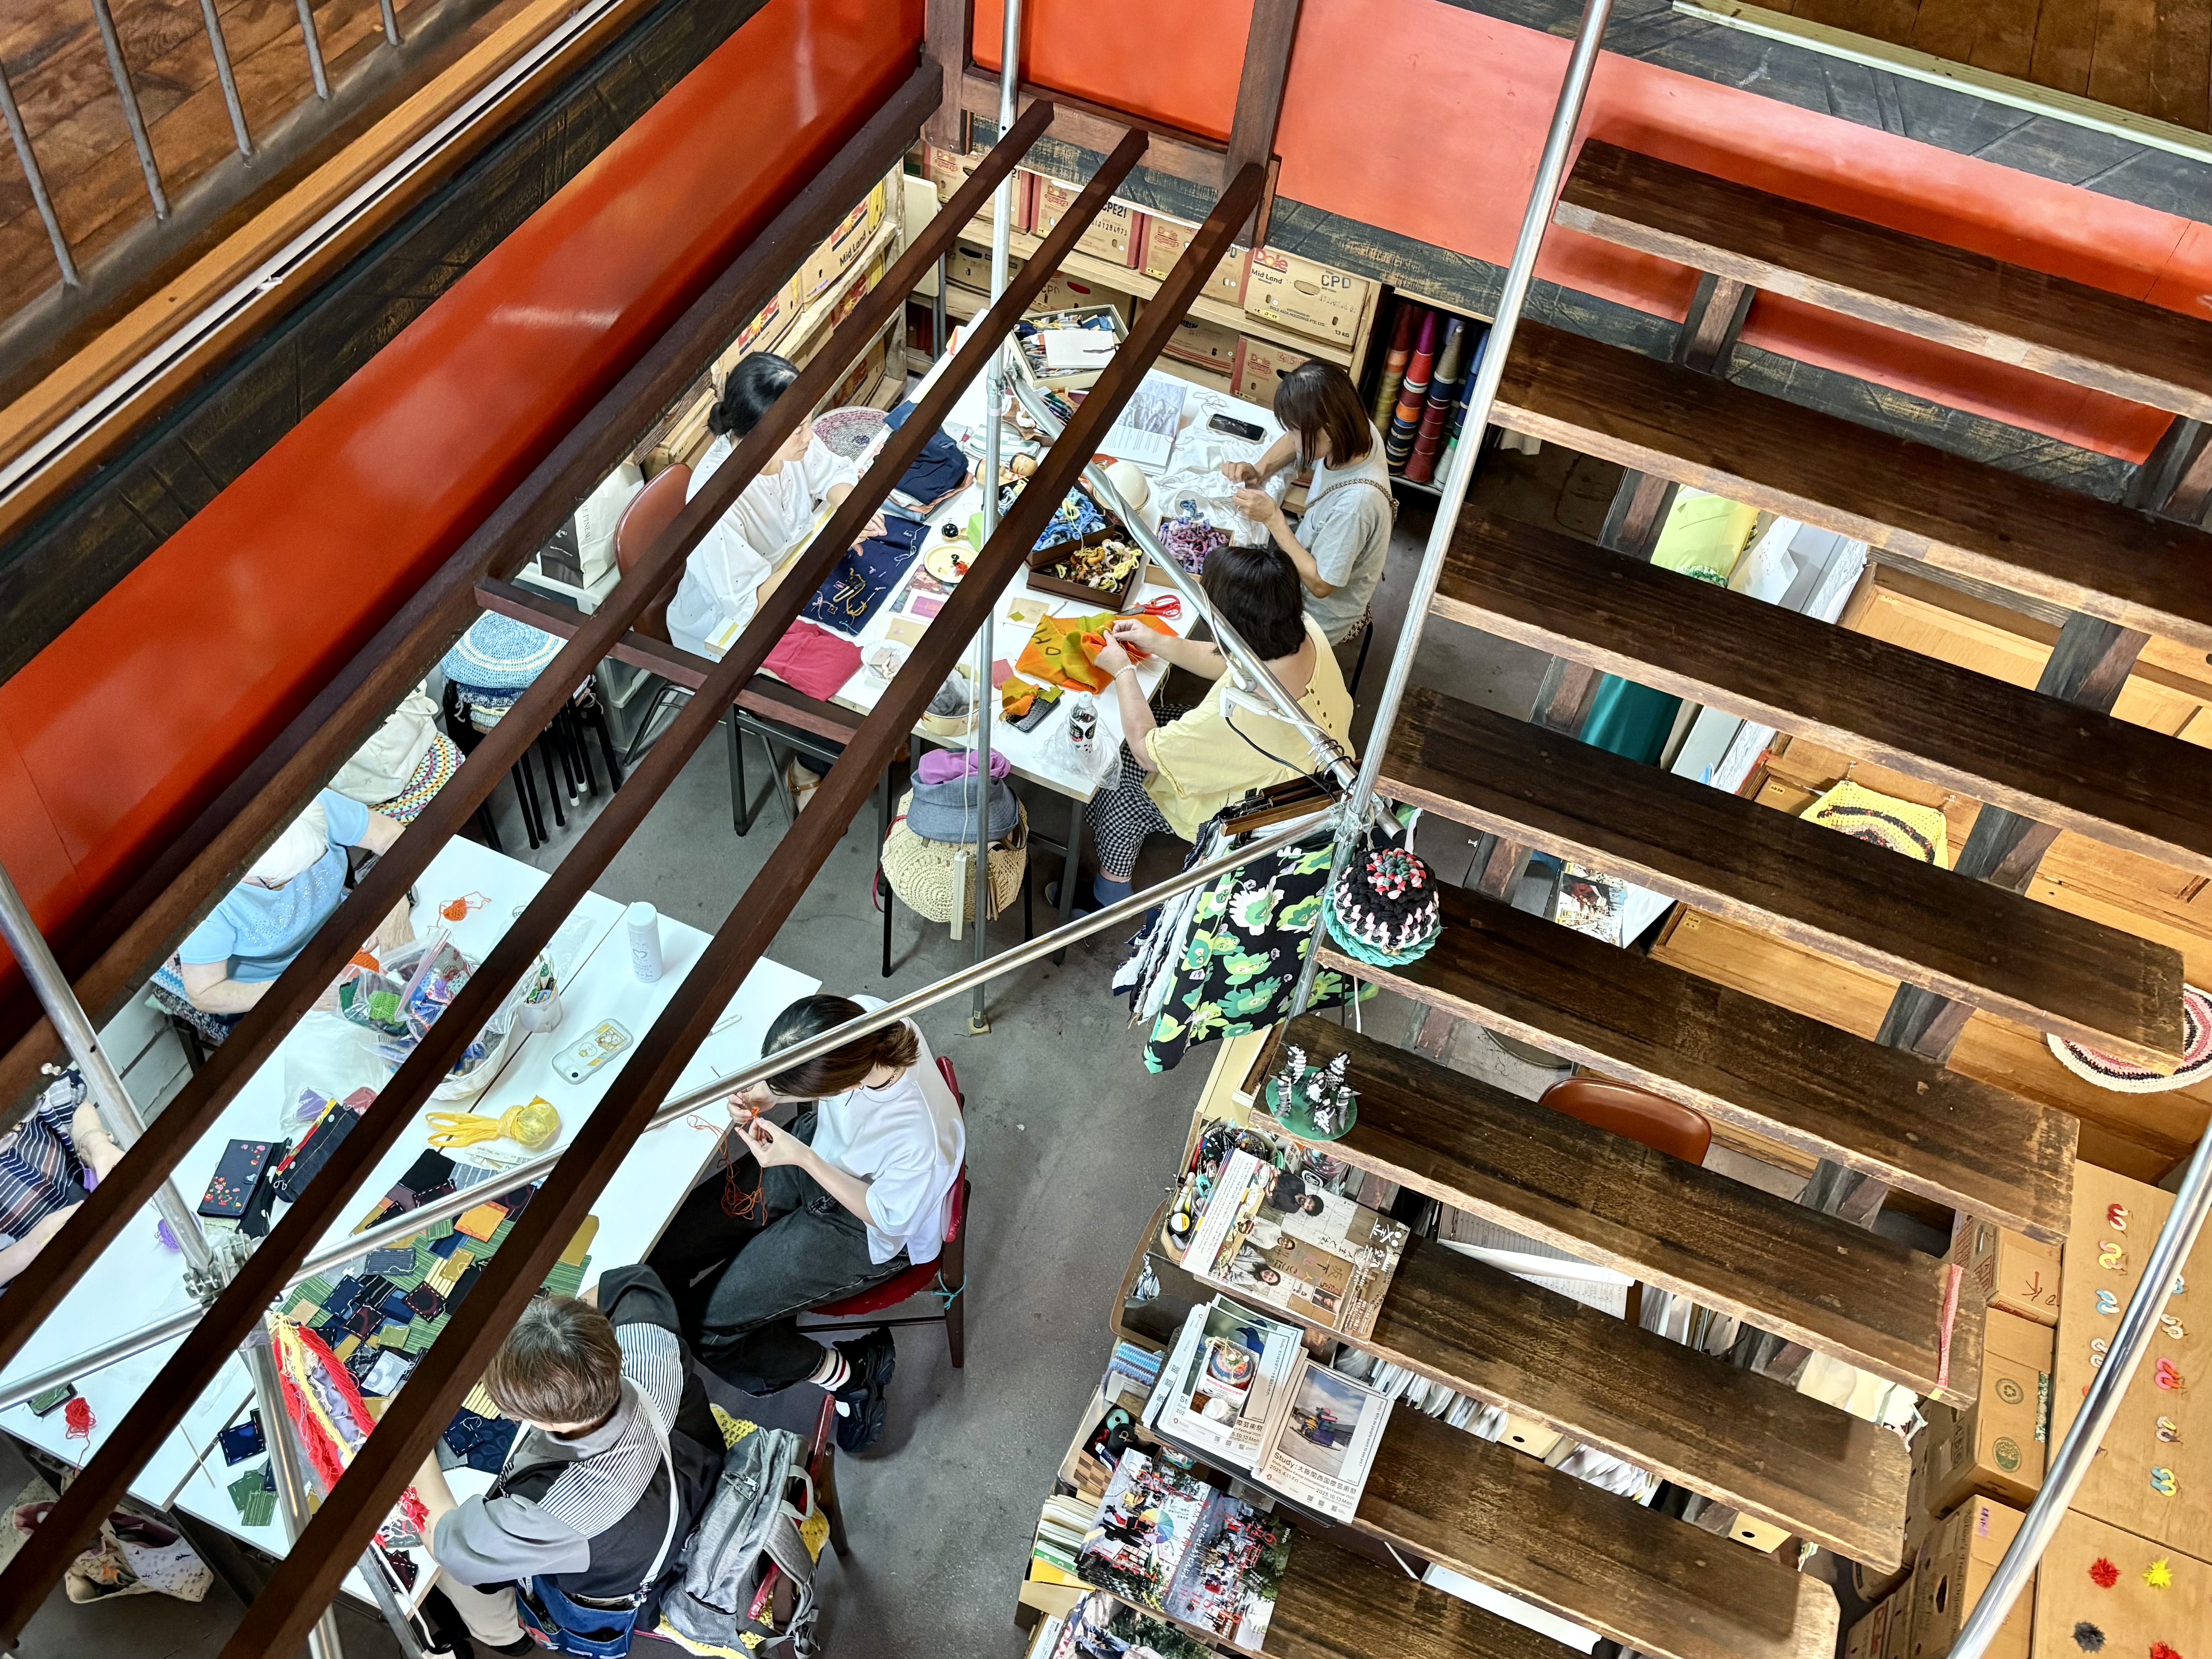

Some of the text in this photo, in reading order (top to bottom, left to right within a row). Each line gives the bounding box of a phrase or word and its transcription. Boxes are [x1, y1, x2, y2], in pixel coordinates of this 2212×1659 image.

[839, 230, 867, 267] Mid Land
[1252, 248, 1290, 271] Dole
[1250, 268, 1283, 284] Mid Land
[1320, 271, 1353, 293] CPD
[1367, 1425, 1375, 1438] people
[1269, 1464, 1291, 1479] 2025.4.11
[1315, 1488, 1342, 1502] 2025.10.13
[1292, 1471, 1304, 1479] Kansai
[1332, 1489, 1345, 1497] Festival
